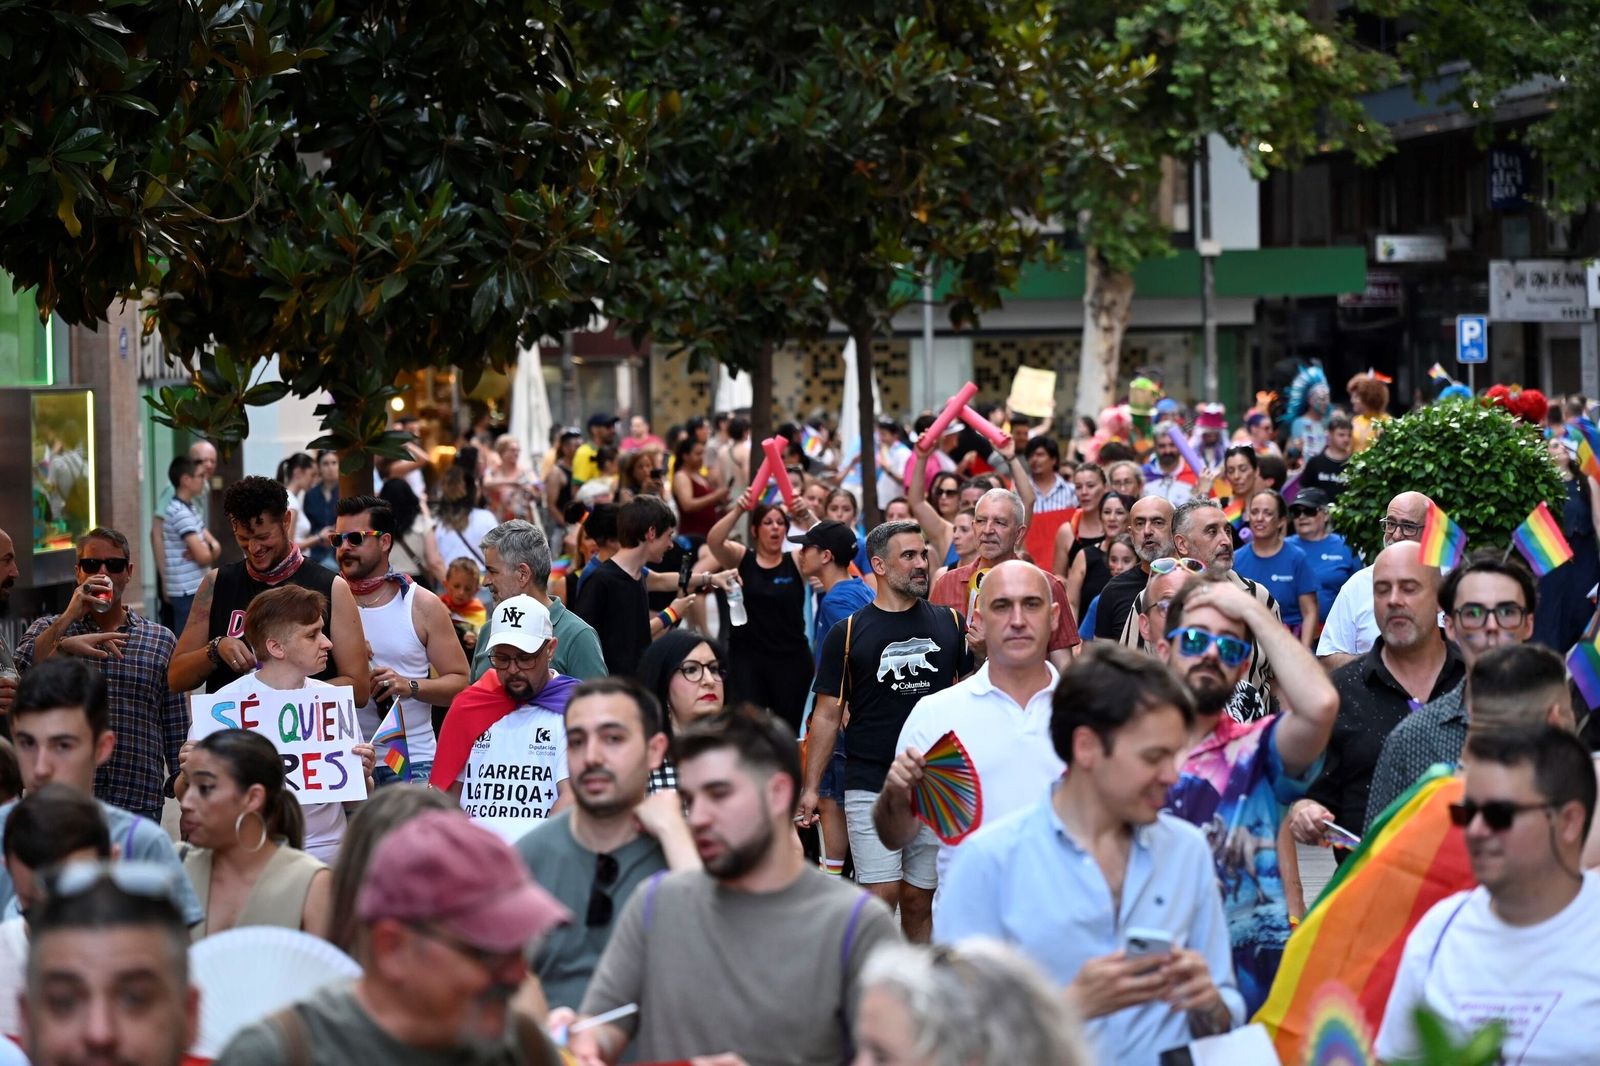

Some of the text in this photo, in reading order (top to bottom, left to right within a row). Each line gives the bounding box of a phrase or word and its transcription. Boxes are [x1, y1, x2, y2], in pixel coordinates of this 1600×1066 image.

[1462, 320, 1482, 347] P
[501, 606, 525, 628] NY
[898, 680, 930, 690] Columbia
[211, 693, 260, 730] SÉ
[281, 751, 348, 791] RES
[478, 764, 553, 781] CARRERA
[467, 782, 554, 805] LGTBIQA+
